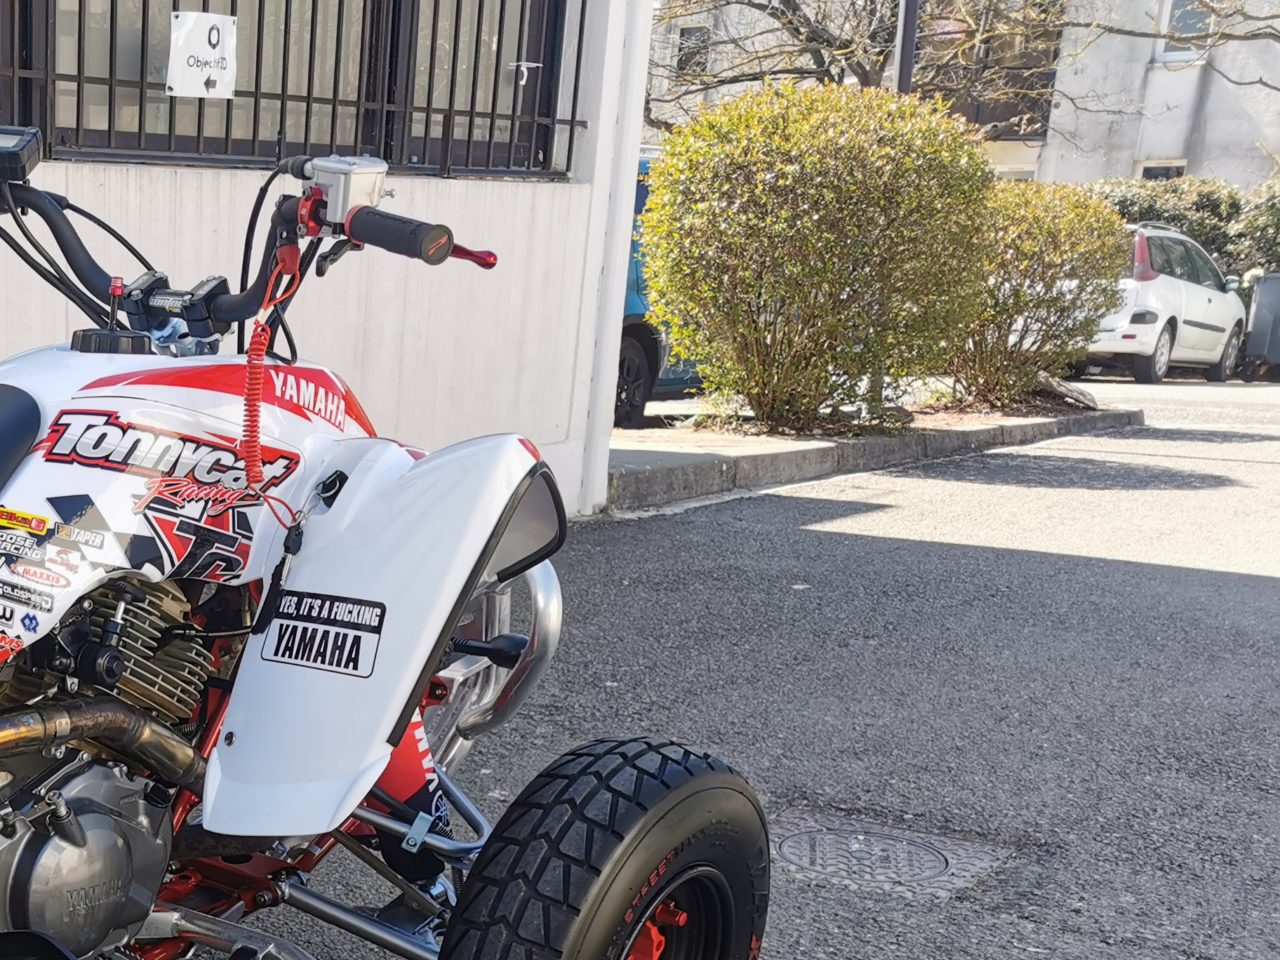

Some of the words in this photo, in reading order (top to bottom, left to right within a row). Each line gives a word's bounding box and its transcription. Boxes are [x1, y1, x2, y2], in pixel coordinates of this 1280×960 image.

[269, 369, 346, 433] YAMAHA
[51, 413, 293, 495] Tonnycat
[134, 478, 249, 516] Racing
[71, 528, 104, 549] TAPER
[23, 567, 61, 586] MAXXIS
[279, 595, 299, 618] YES,
[299, 597, 322, 618] IT'S
[320, 600, 331, 620] A
[330, 601, 382, 627] FUCKING
[273, 622, 362, 672] YAMAHA
